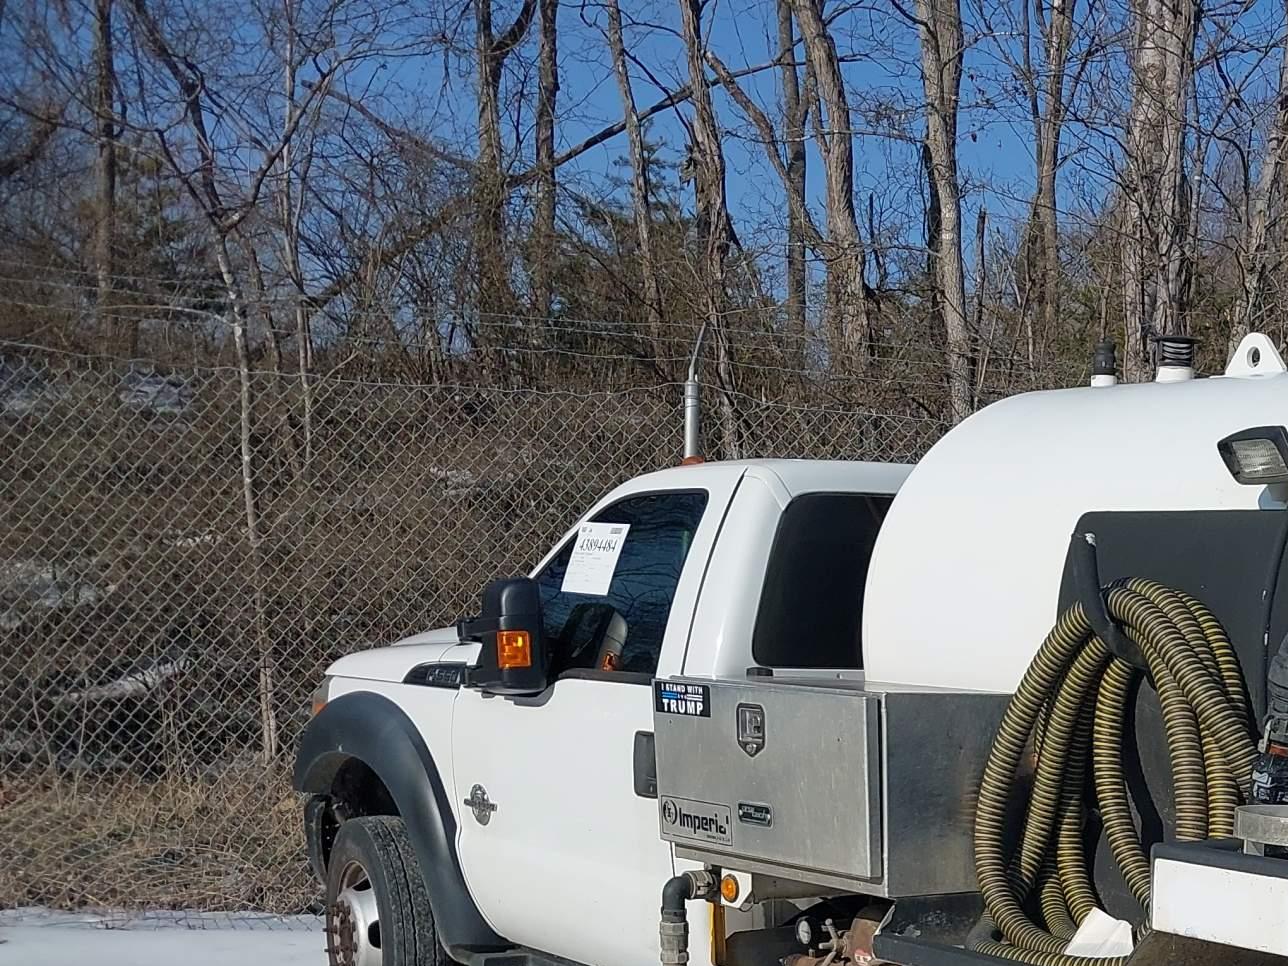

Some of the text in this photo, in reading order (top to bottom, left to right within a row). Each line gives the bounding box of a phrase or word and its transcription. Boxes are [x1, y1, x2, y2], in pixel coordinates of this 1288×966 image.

[578, 539, 618, 552] 43894484
[665, 683, 686, 693] STAND
[686, 686, 703, 694] WITH
[662, 698, 703, 715] TRUMP
